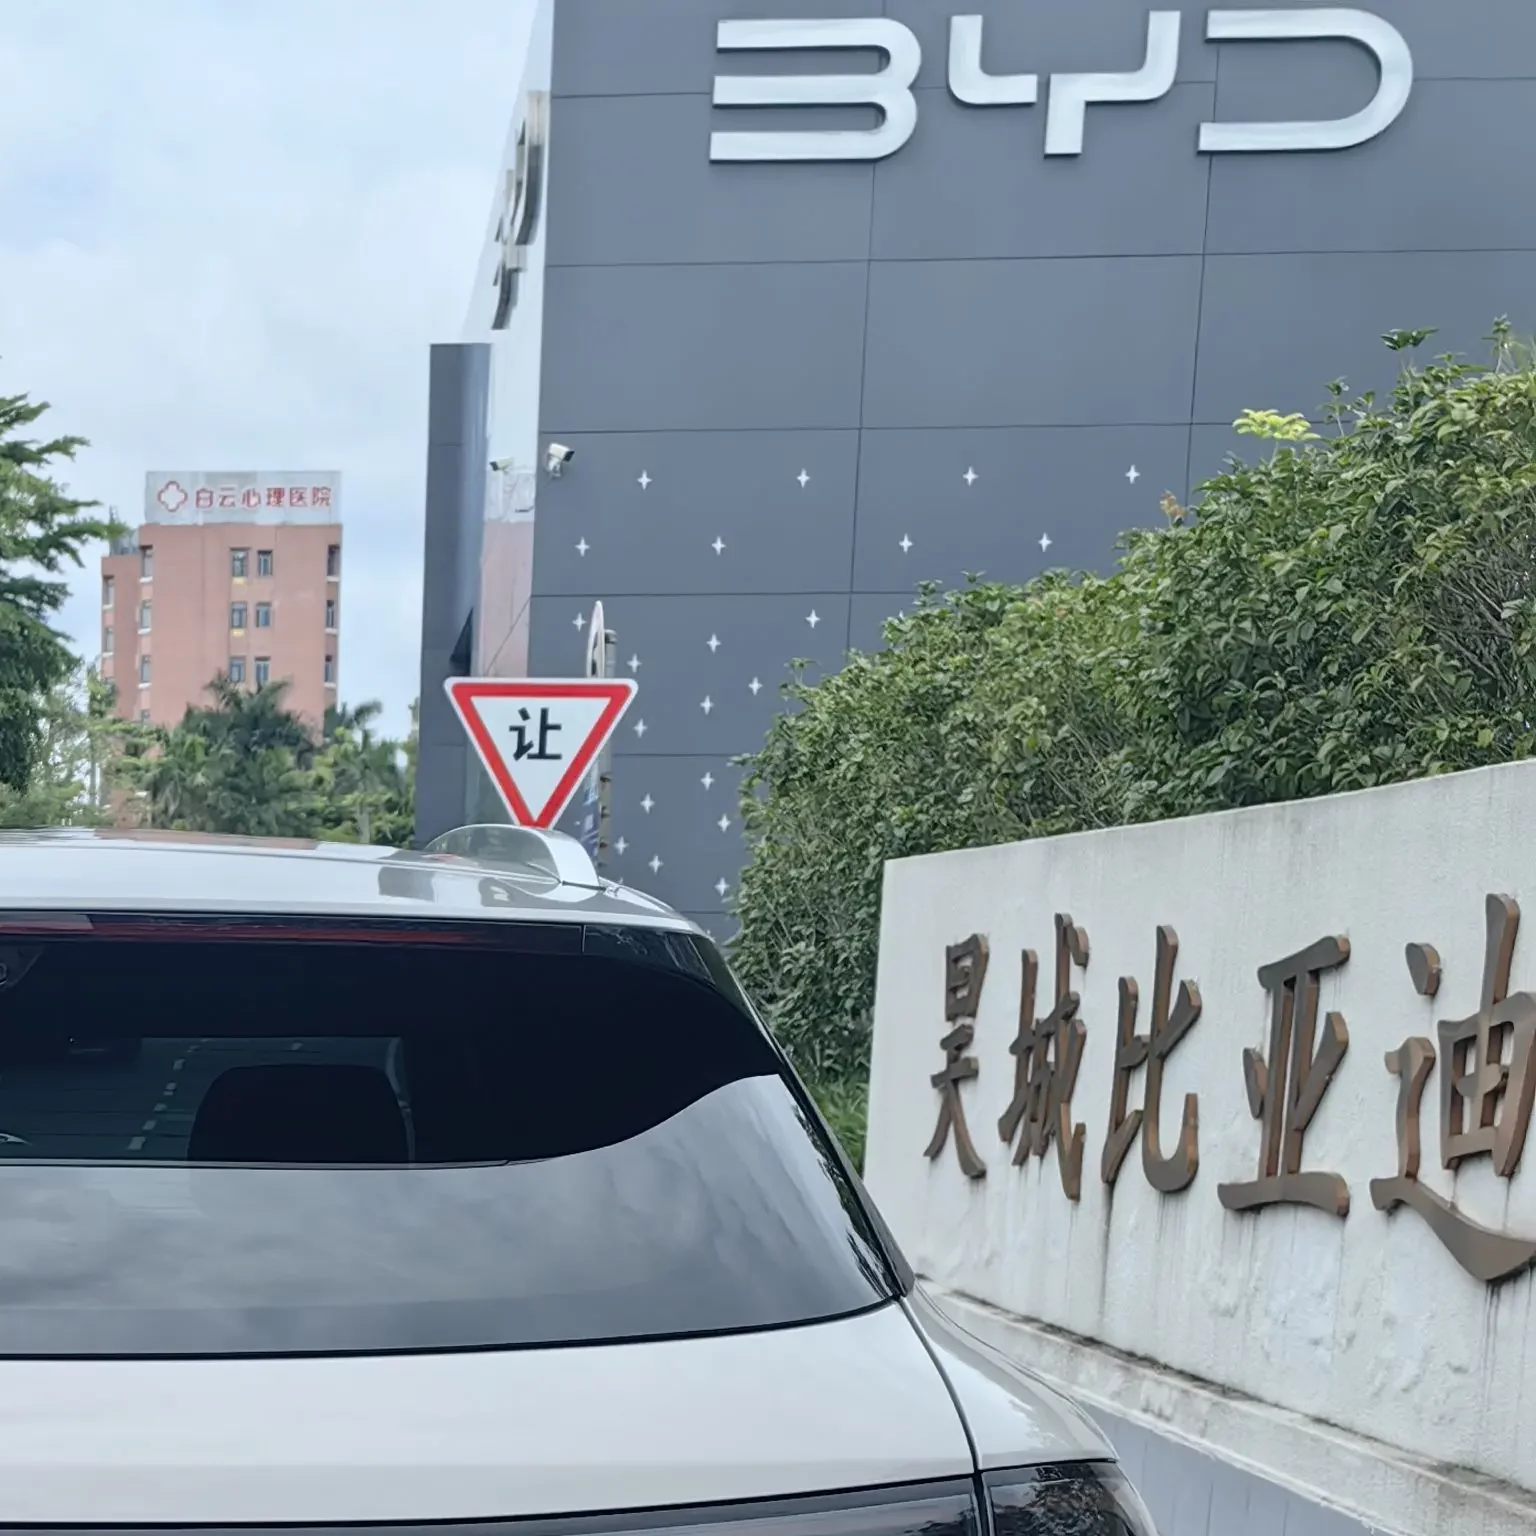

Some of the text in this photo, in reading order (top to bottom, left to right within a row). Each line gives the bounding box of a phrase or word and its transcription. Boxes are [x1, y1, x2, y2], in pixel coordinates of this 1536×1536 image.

[710, 7, 1414, 163] BYD
[195, 486, 332, 509] 白云心理医院
[508, 707, 563, 762] 让
[923, 893, 1536, 1281] 昊城比亚迪
